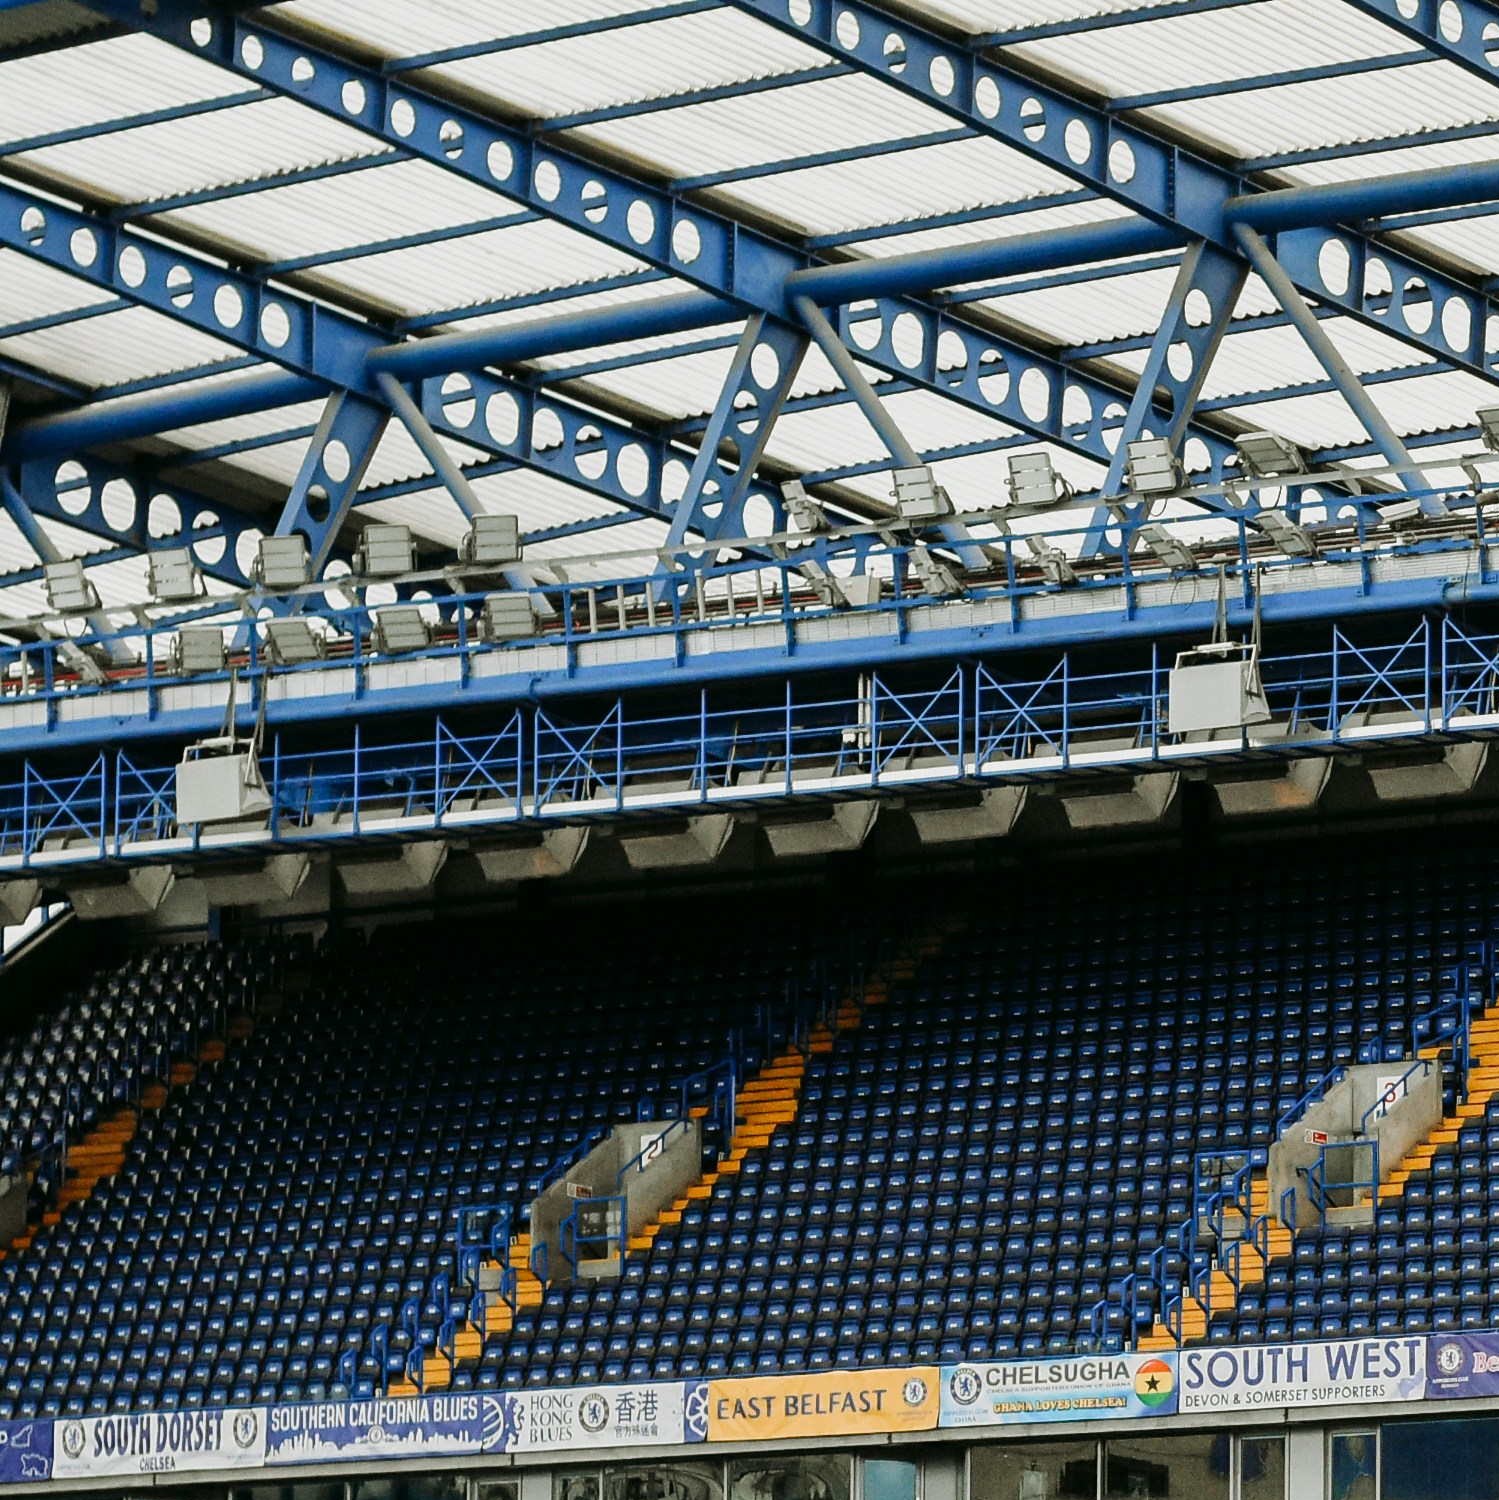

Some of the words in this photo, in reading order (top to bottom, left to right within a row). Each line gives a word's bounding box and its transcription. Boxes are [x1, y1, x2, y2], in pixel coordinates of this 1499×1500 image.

[985, 1361, 1131, 1387] CHELSUGHA
[1185, 1347, 1309, 1389] SOUTH
[1324, 1340, 1421, 1381] WEST
[530, 1394, 573, 1410] HONG
[614, 1389, 659, 1423] 香港
[716, 1396, 777, 1420] EAST
[784, 1390, 887, 1417] BELFAST
[993, 1400, 1033, 1414] GHANA
[1035, 1398, 1071, 1411] LOVES
[1072, 1396, 1127, 1410] CHELSEA!
[1185, 1393, 1229, 1407] DEVON
[1233, 1393, 1241, 1404] &
[1245, 1389, 1307, 1404] SOMERSET
[1311, 1384, 1385, 1401] SUPPORTERS
[271, 1403, 346, 1431] SOUTHERN
[349, 1399, 429, 1427] CALIFORNIA
[433, 1396, 478, 1422] BLUES
[530, 1410, 573, 1427] KONG
[93, 1414, 152, 1457] SOUTH
[156, 1410, 224, 1452] DORSET
[530, 1426, 573, 1443] BLUES
[139, 1455, 176, 1472] CHELSEA
